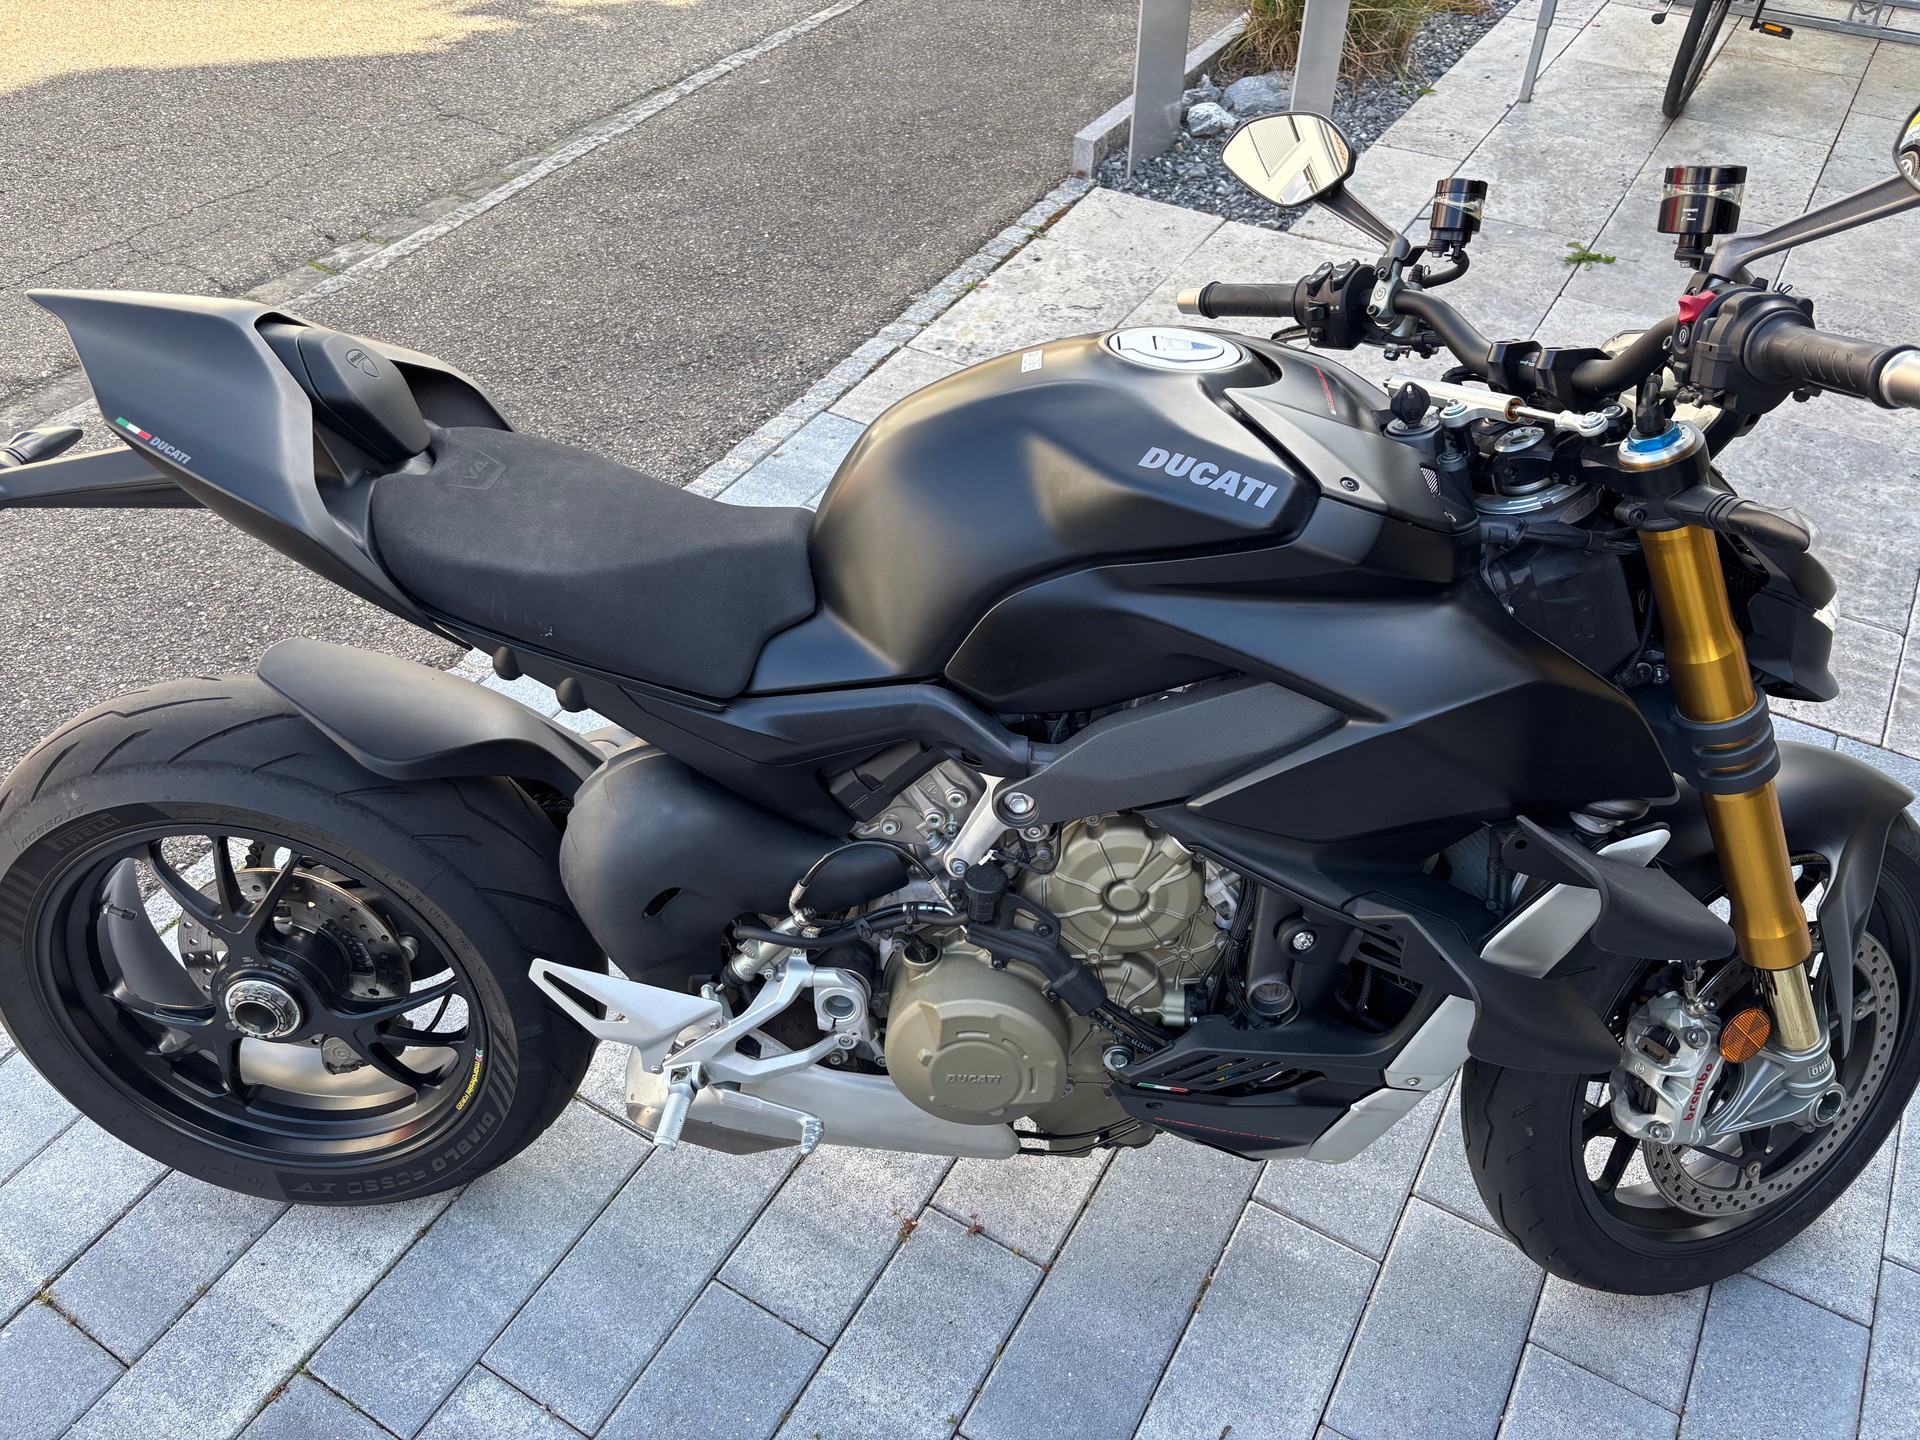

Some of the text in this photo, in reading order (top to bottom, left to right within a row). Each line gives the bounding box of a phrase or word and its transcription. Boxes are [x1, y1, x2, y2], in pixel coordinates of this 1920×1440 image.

[149, 436, 192, 465] DUCATI
[1137, 446, 1278, 509] DUCATI
[46, 811, 121, 851] PIRELLI
[946, 1073, 1001, 1084] DUCATI
[1683, 1063, 1713, 1121] brembo
[431, 1109, 497, 1172] DIABLO
[348, 1172, 427, 1194] ROSSO
